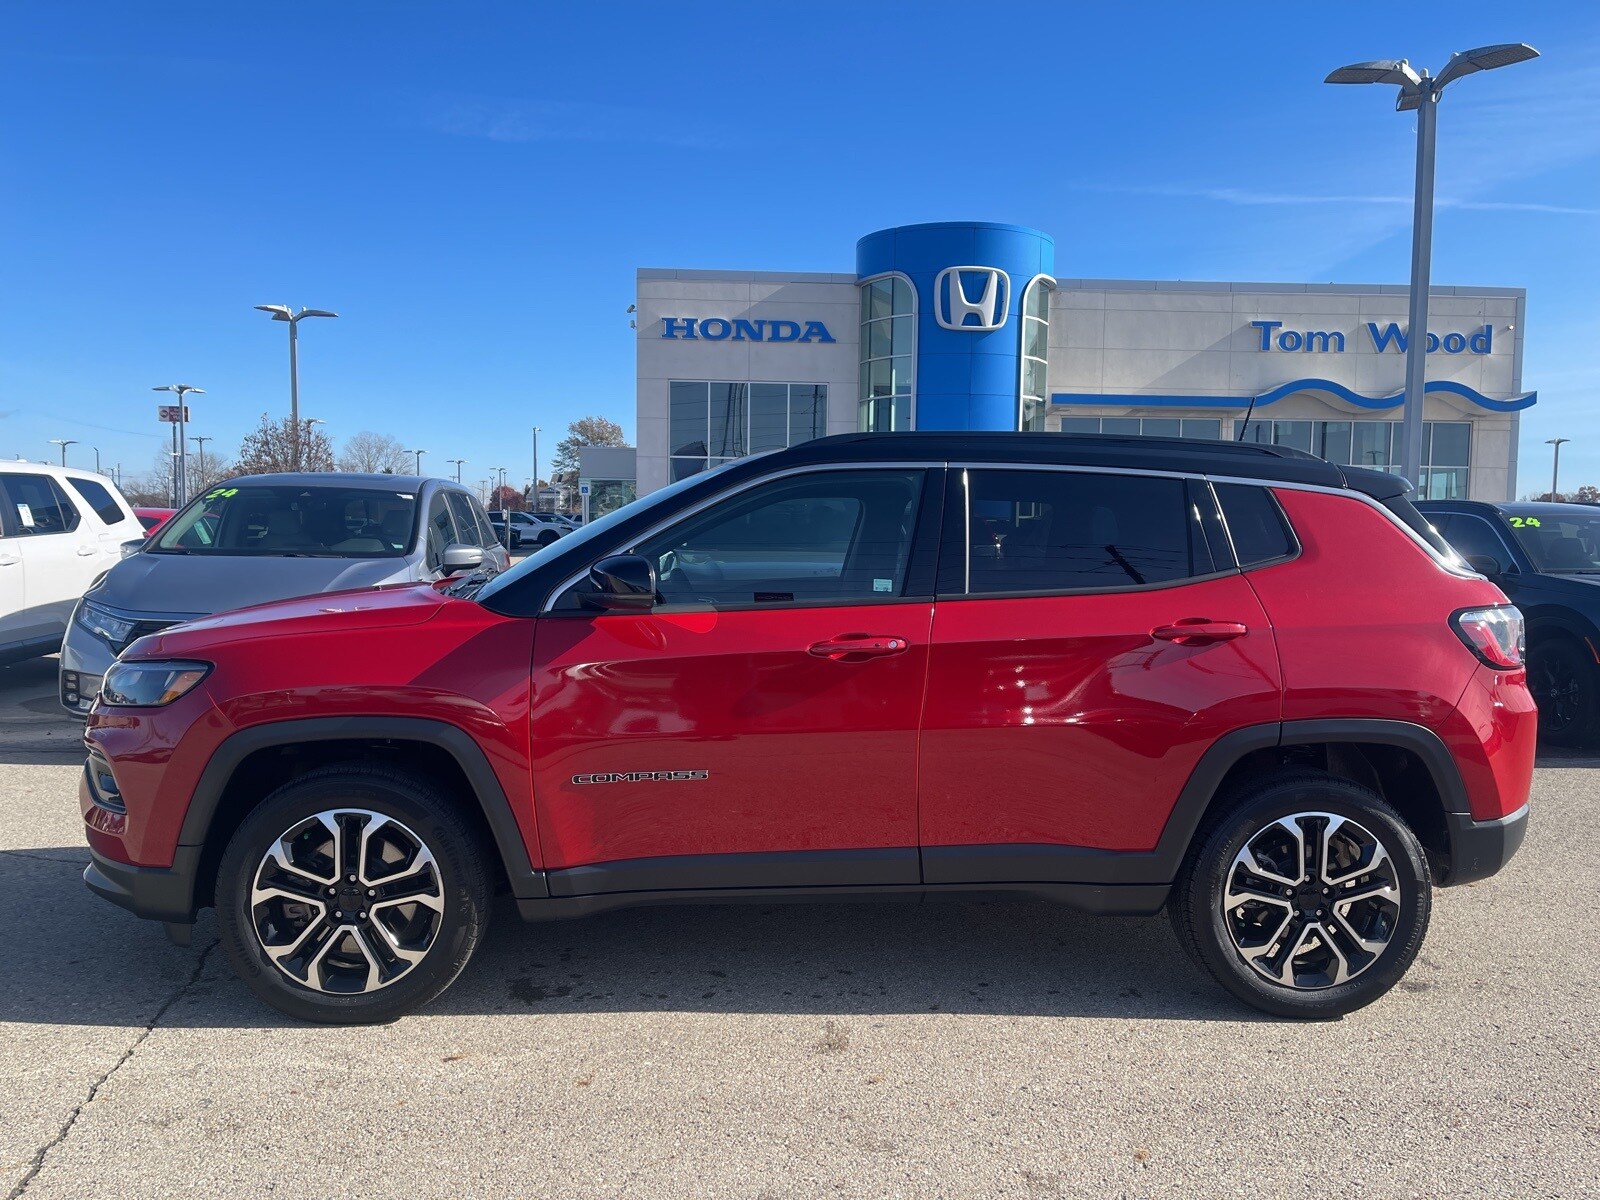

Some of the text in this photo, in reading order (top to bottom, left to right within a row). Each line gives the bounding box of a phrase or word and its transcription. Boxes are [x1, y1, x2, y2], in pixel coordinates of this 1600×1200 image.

[661, 316, 837, 343] HONDA
[1251, 320, 1345, 352] Tom
[1509, 516, 1541, 528] 24
[571, 769, 709, 785] COMPASS
